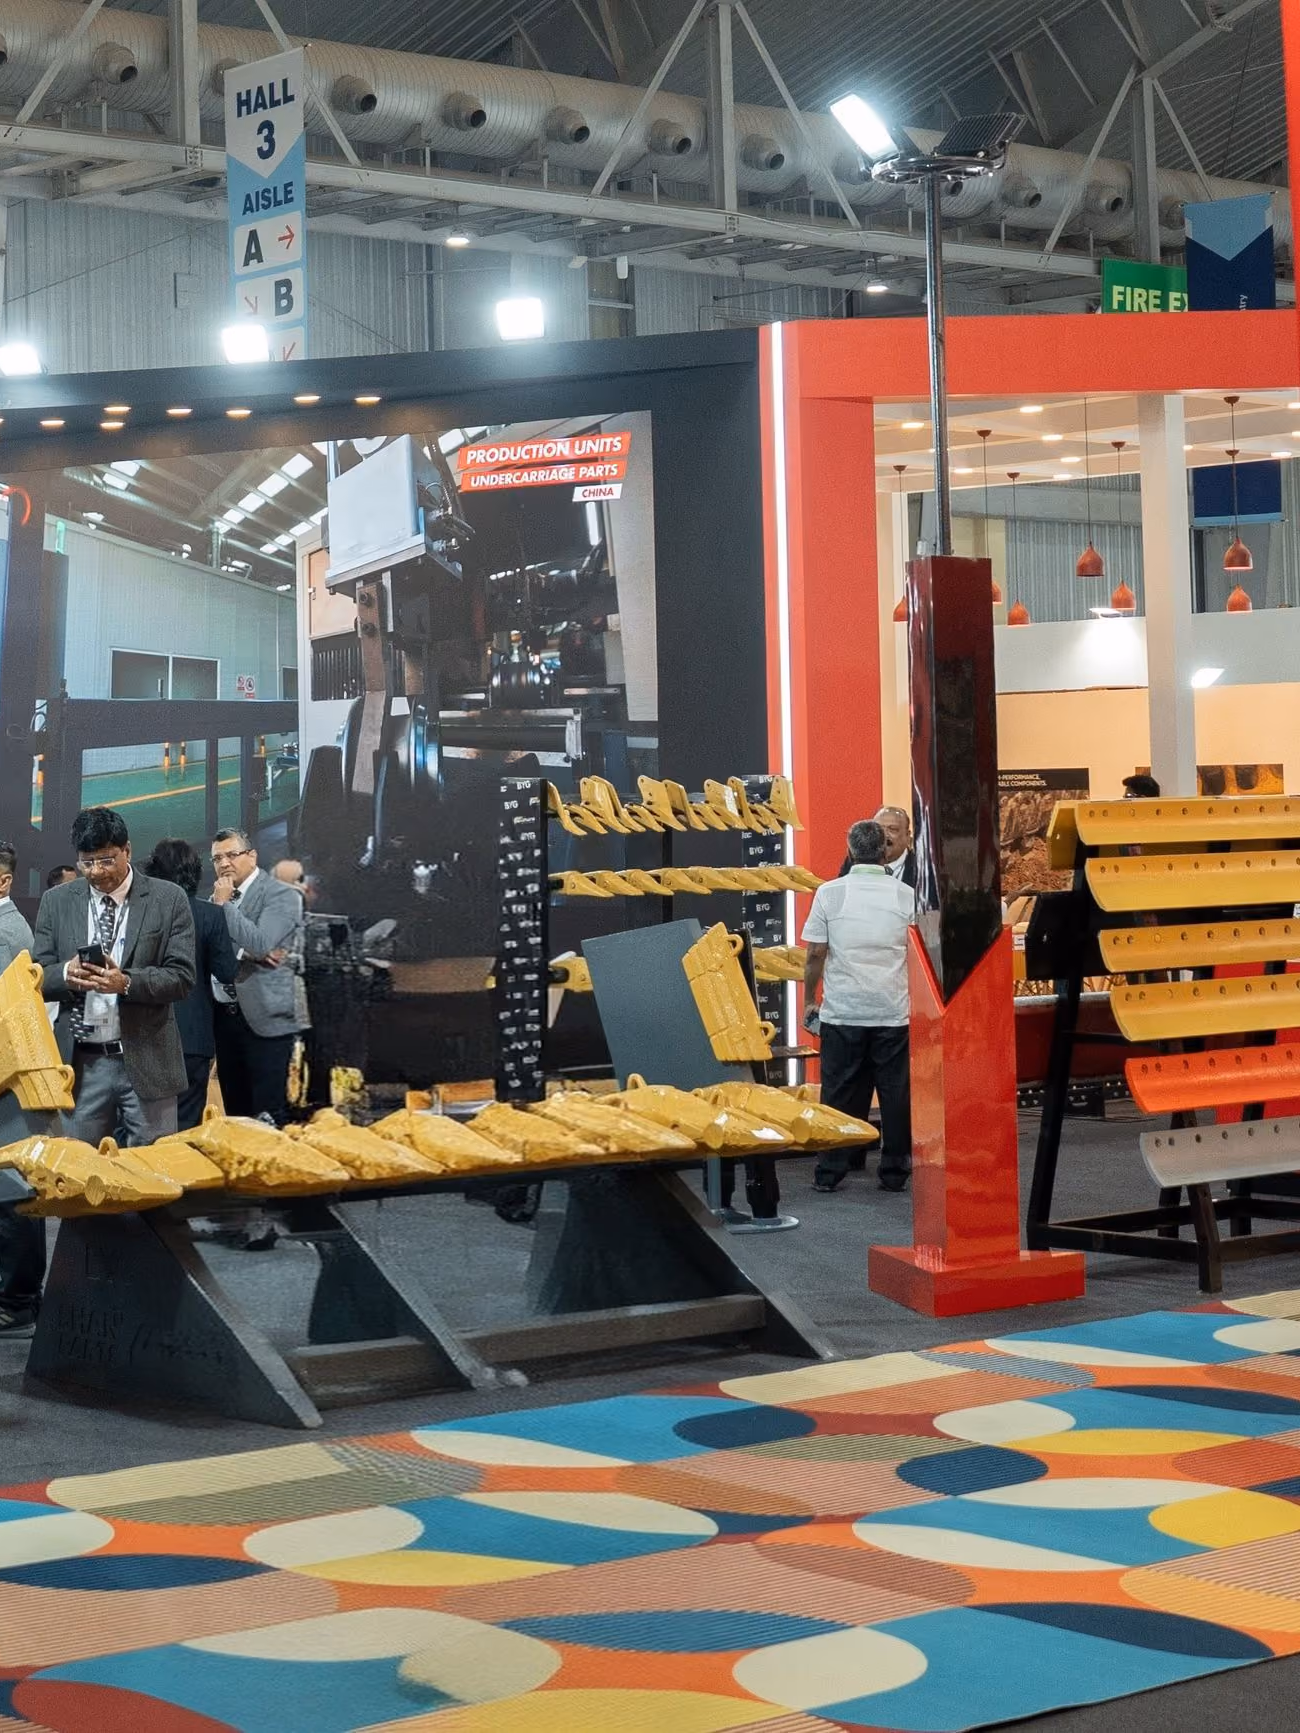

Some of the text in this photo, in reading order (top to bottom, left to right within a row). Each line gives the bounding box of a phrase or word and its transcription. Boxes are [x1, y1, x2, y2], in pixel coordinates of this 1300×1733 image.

[236, 77, 295, 118] HALL
[256, 119, 276, 160] 3
[241, 181, 294, 216] AISLE
[242, 229, 264, 267] A
[274, 278, 294, 317] B
[1112, 284, 1162, 313] FIRE
[466, 436, 622, 465] PRODUCTION UNITS
[470, 463, 618, 487] UNDERCARRIAGE PARTS
[581, 487, 614, 499] CHINA
[504, 800, 519, 810] BYG
[748, 846, 764, 855] BYG
[756, 903, 771, 912] BYG
[764, 1011, 779, 1020] BYG
